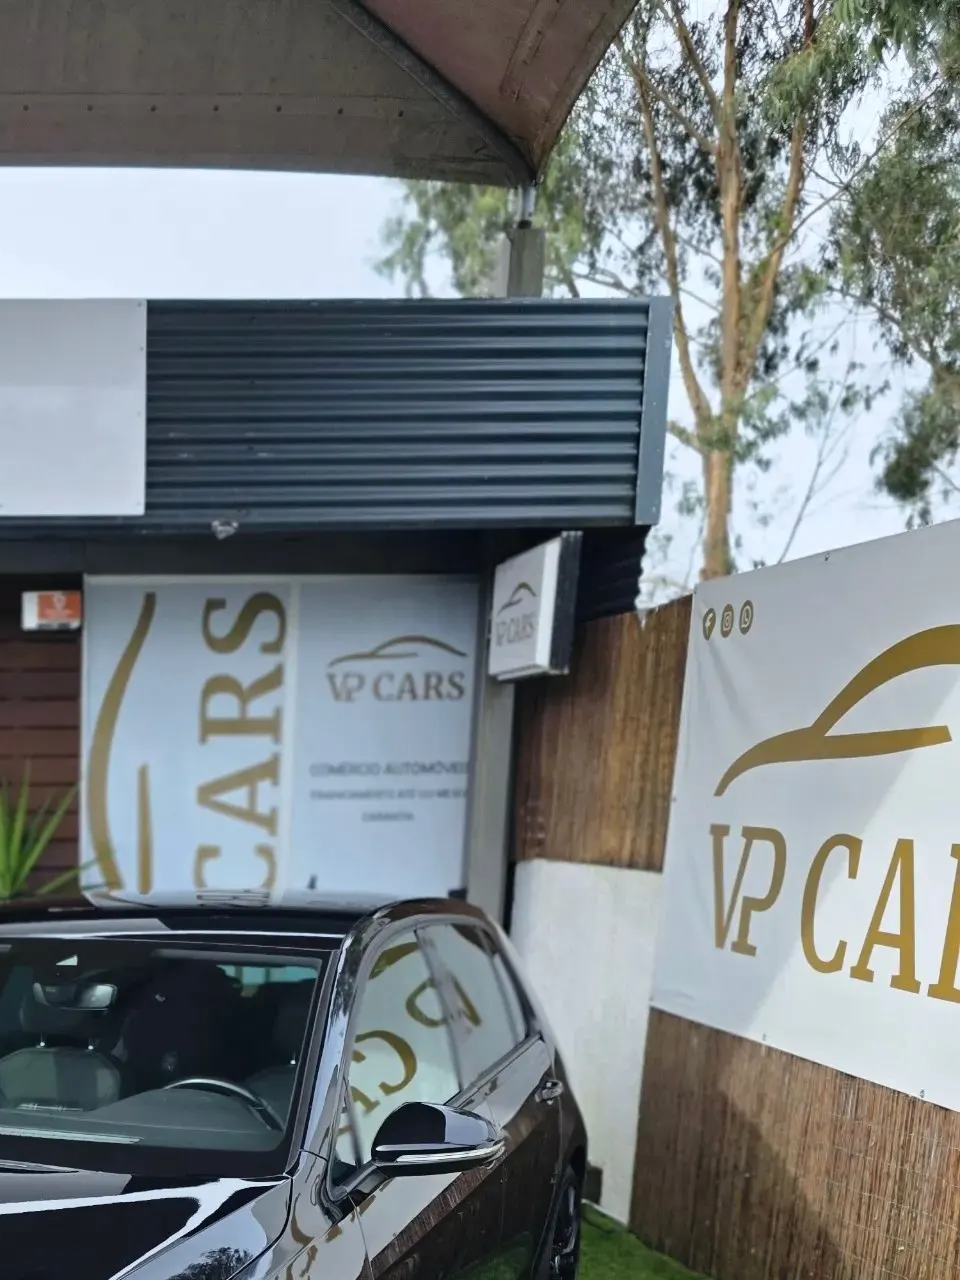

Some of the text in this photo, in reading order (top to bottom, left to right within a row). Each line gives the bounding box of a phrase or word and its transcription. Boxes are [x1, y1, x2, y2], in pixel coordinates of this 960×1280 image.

[194, 591, 288, 889] CARS
[326, 670, 466, 703] VP CARS
[709, 823, 787, 957] VP
